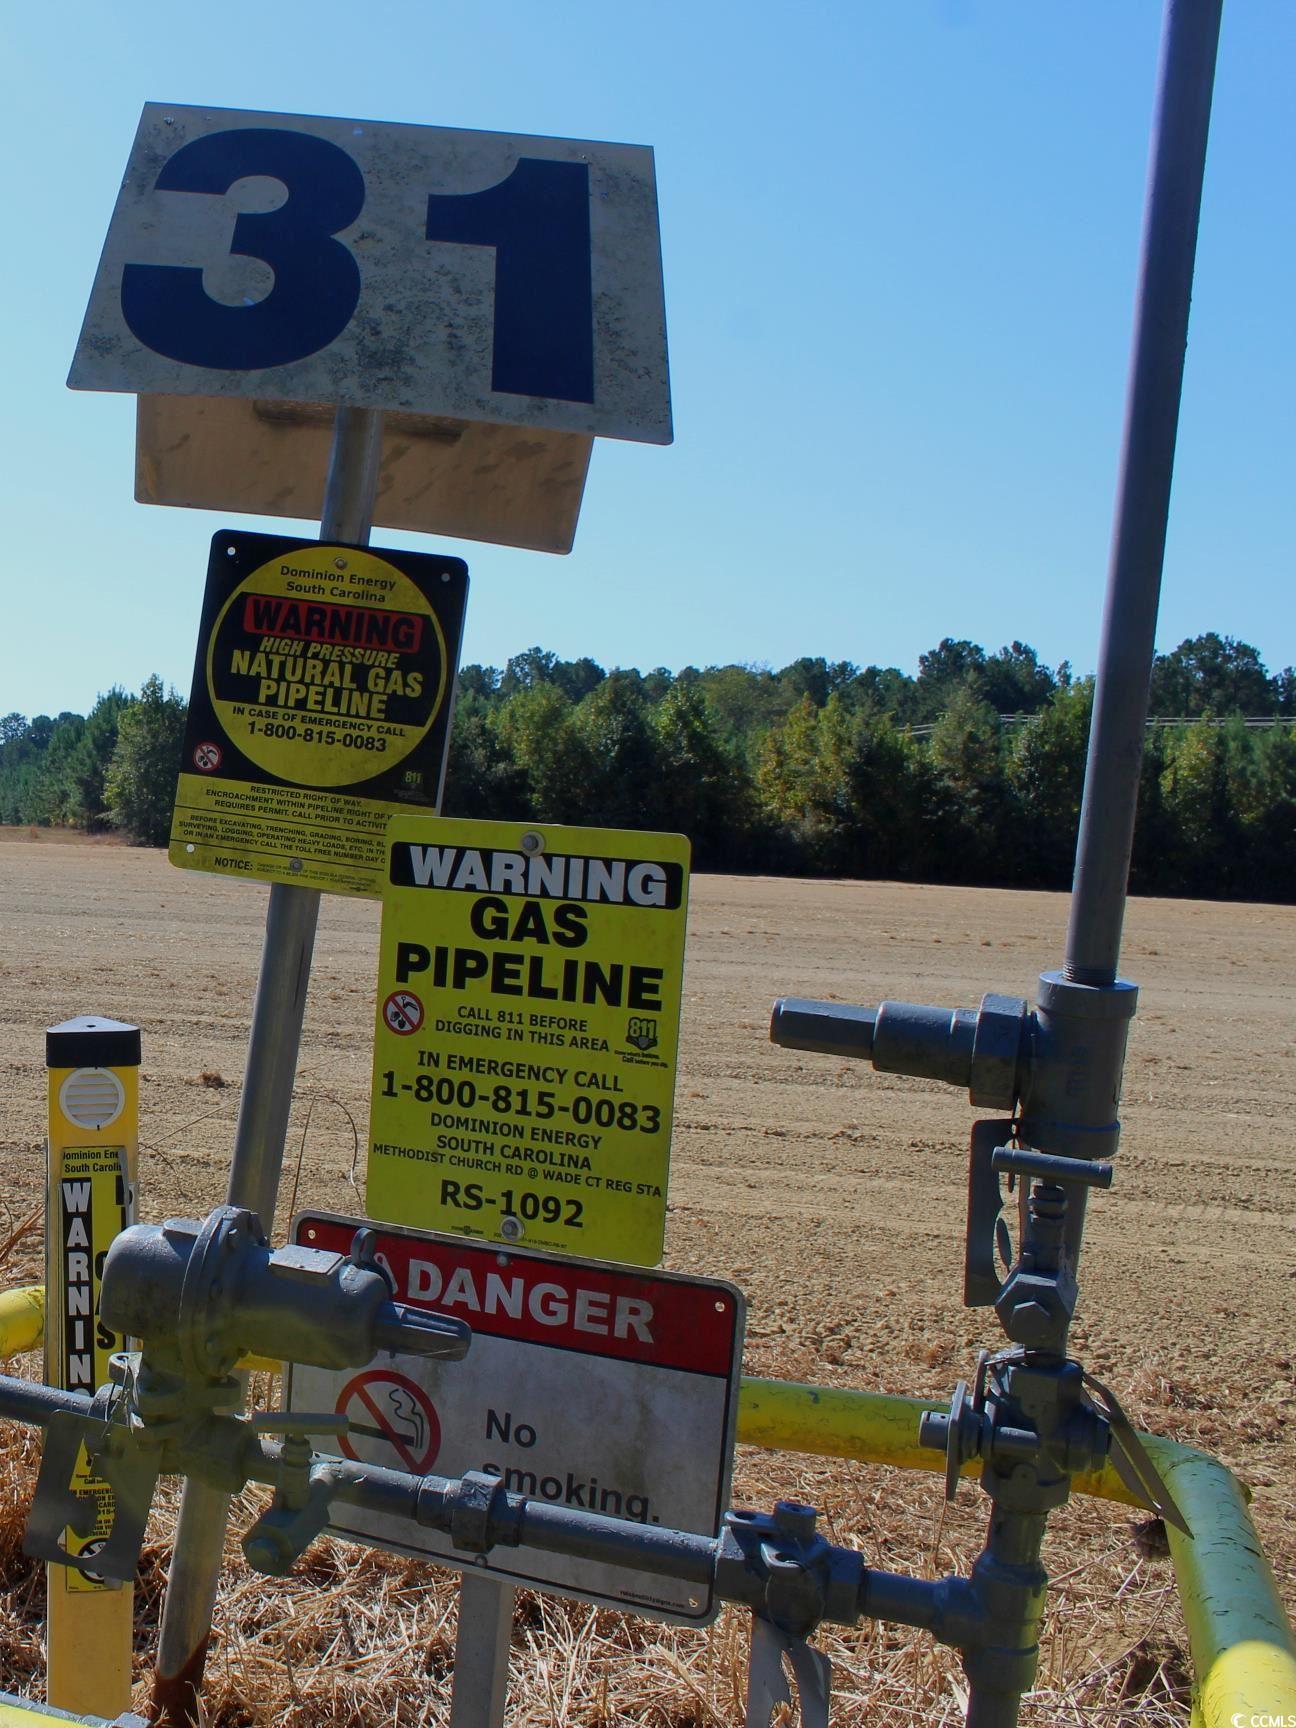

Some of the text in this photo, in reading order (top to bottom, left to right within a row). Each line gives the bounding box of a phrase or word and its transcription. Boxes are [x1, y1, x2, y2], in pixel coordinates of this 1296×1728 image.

[121, 128, 594, 404] 31
[281, 565, 396, 591] Dominion Energy
[286, 581, 386, 602] South Carolina
[254, 600, 416, 649] WARNING
[259, 637, 400, 668] HIGH PRESSURE
[230, 650, 424, 698] NATURAL GAS
[258, 679, 388, 719] PIPELINE
[232, 706, 405, 737] IN CASE OF EMERGENCY CALL
[248, 720, 387, 752] 1-800-815-0083
[206, 789, 274, 805] ENCROACHMENT
[276, 799, 305, 809] WITHIN
[308, 803, 344, 815] PIPELINE
[347, 809, 371, 818] RIGHT
[250, 785, 301, 799] RESTRICTED
[303, 792, 327, 802] RIGHT
[344, 798, 362, 807] WAY.
[190, 815, 217, 824] BEFORE
[219, 818, 263, 831] EXCAVATING,
[265, 825, 307, 837] TRENCHING,
[309, 831, 343, 842] GRADING,
[214, 800, 255, 812] REQUIRES
[258, 806, 289, 817] PERMIT.
[292, 810, 312, 820] CALL
[315, 814, 340, 824] PRIOR
[356, 820, 387, 830] ACTIVIT
[215, 834, 259, 846] EMERGENCY
[260, 840, 277, 848] CALL
[280, 843, 293, 851] THE
[295, 846, 312, 854] TOLL
[314, 848, 331, 856] FREE
[333, 850, 364, 861] NUMBER
[256, 832, 298, 843] OPERATING
[298, 838, 321, 847] HEAVY
[214, 857, 253, 870] NOTICE:
[409, 845, 666, 906] WARNING
[470, 896, 588, 948] GAS
[395, 942, 663, 1011] PIPELINE
[457, 1005, 587, 1032] CALL 811 BEFORE
[628, 1017, 656, 1039] 811
[435, 1020, 610, 1052] DIGGING IN THIS AREA
[418, 1050, 623, 1093] IN EMERGENCY CALL
[381, 1070, 661, 1134] 1-800-815-0083
[430, 1112, 602, 1151] DOMINION ENERGY
[65, 1163, 90, 1173] South
[436, 1134, 592, 1171] SOUTH CAROLINA
[373, 1143, 661, 1197] METHODIST CHURCH RD @ WADE CT REG STA
[440, 1180, 583, 1228] RS-1092
[408, 1258, 654, 1344] DANGER
[486, 1409, 536, 1448] No
